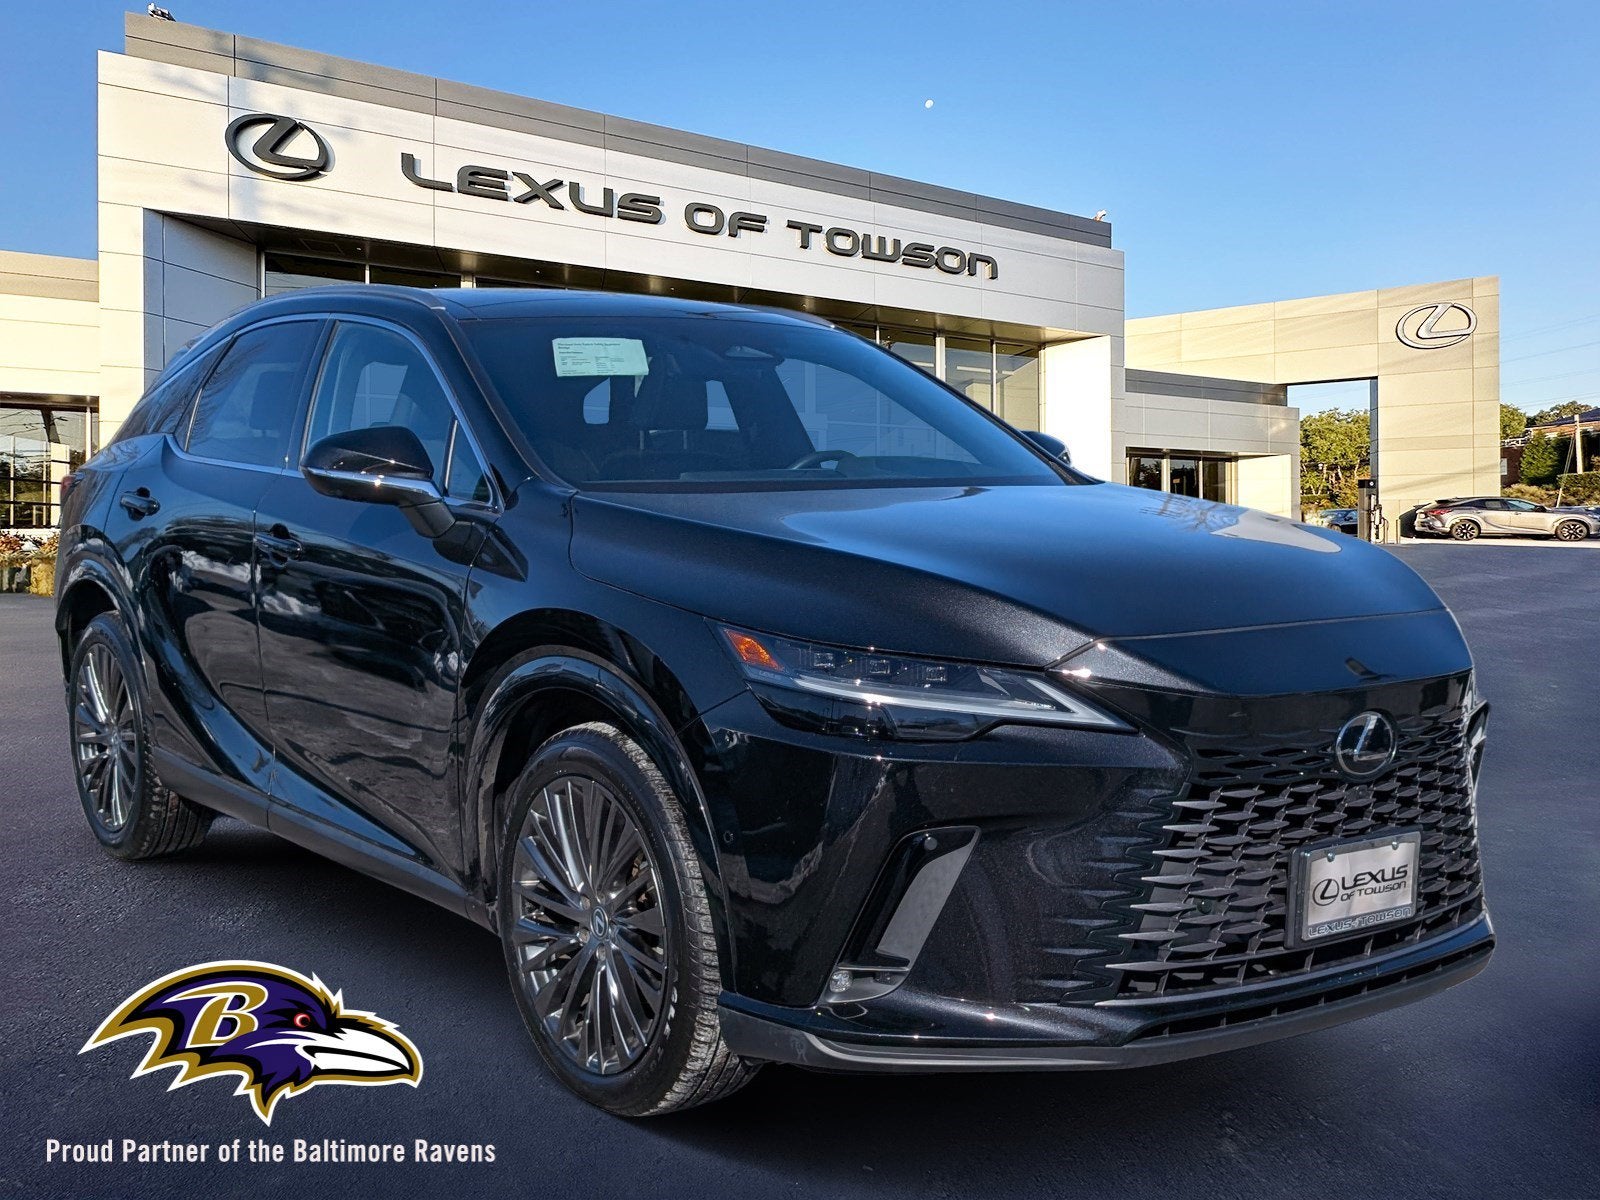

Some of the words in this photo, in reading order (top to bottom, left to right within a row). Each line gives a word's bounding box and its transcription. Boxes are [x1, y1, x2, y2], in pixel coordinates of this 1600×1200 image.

[401, 152, 662, 225] LEXUS
[684, 202, 767, 238] OF
[787, 219, 999, 280] TOWSON
[1340, 891, 1355, 901] OF
[1358, 880, 1407, 897] TOWSON
[1341, 864, 1408, 890] LEXUS
[1308, 919, 1351, 938] LEXUS
[1361, 906, 1412, 925] TOWSON
